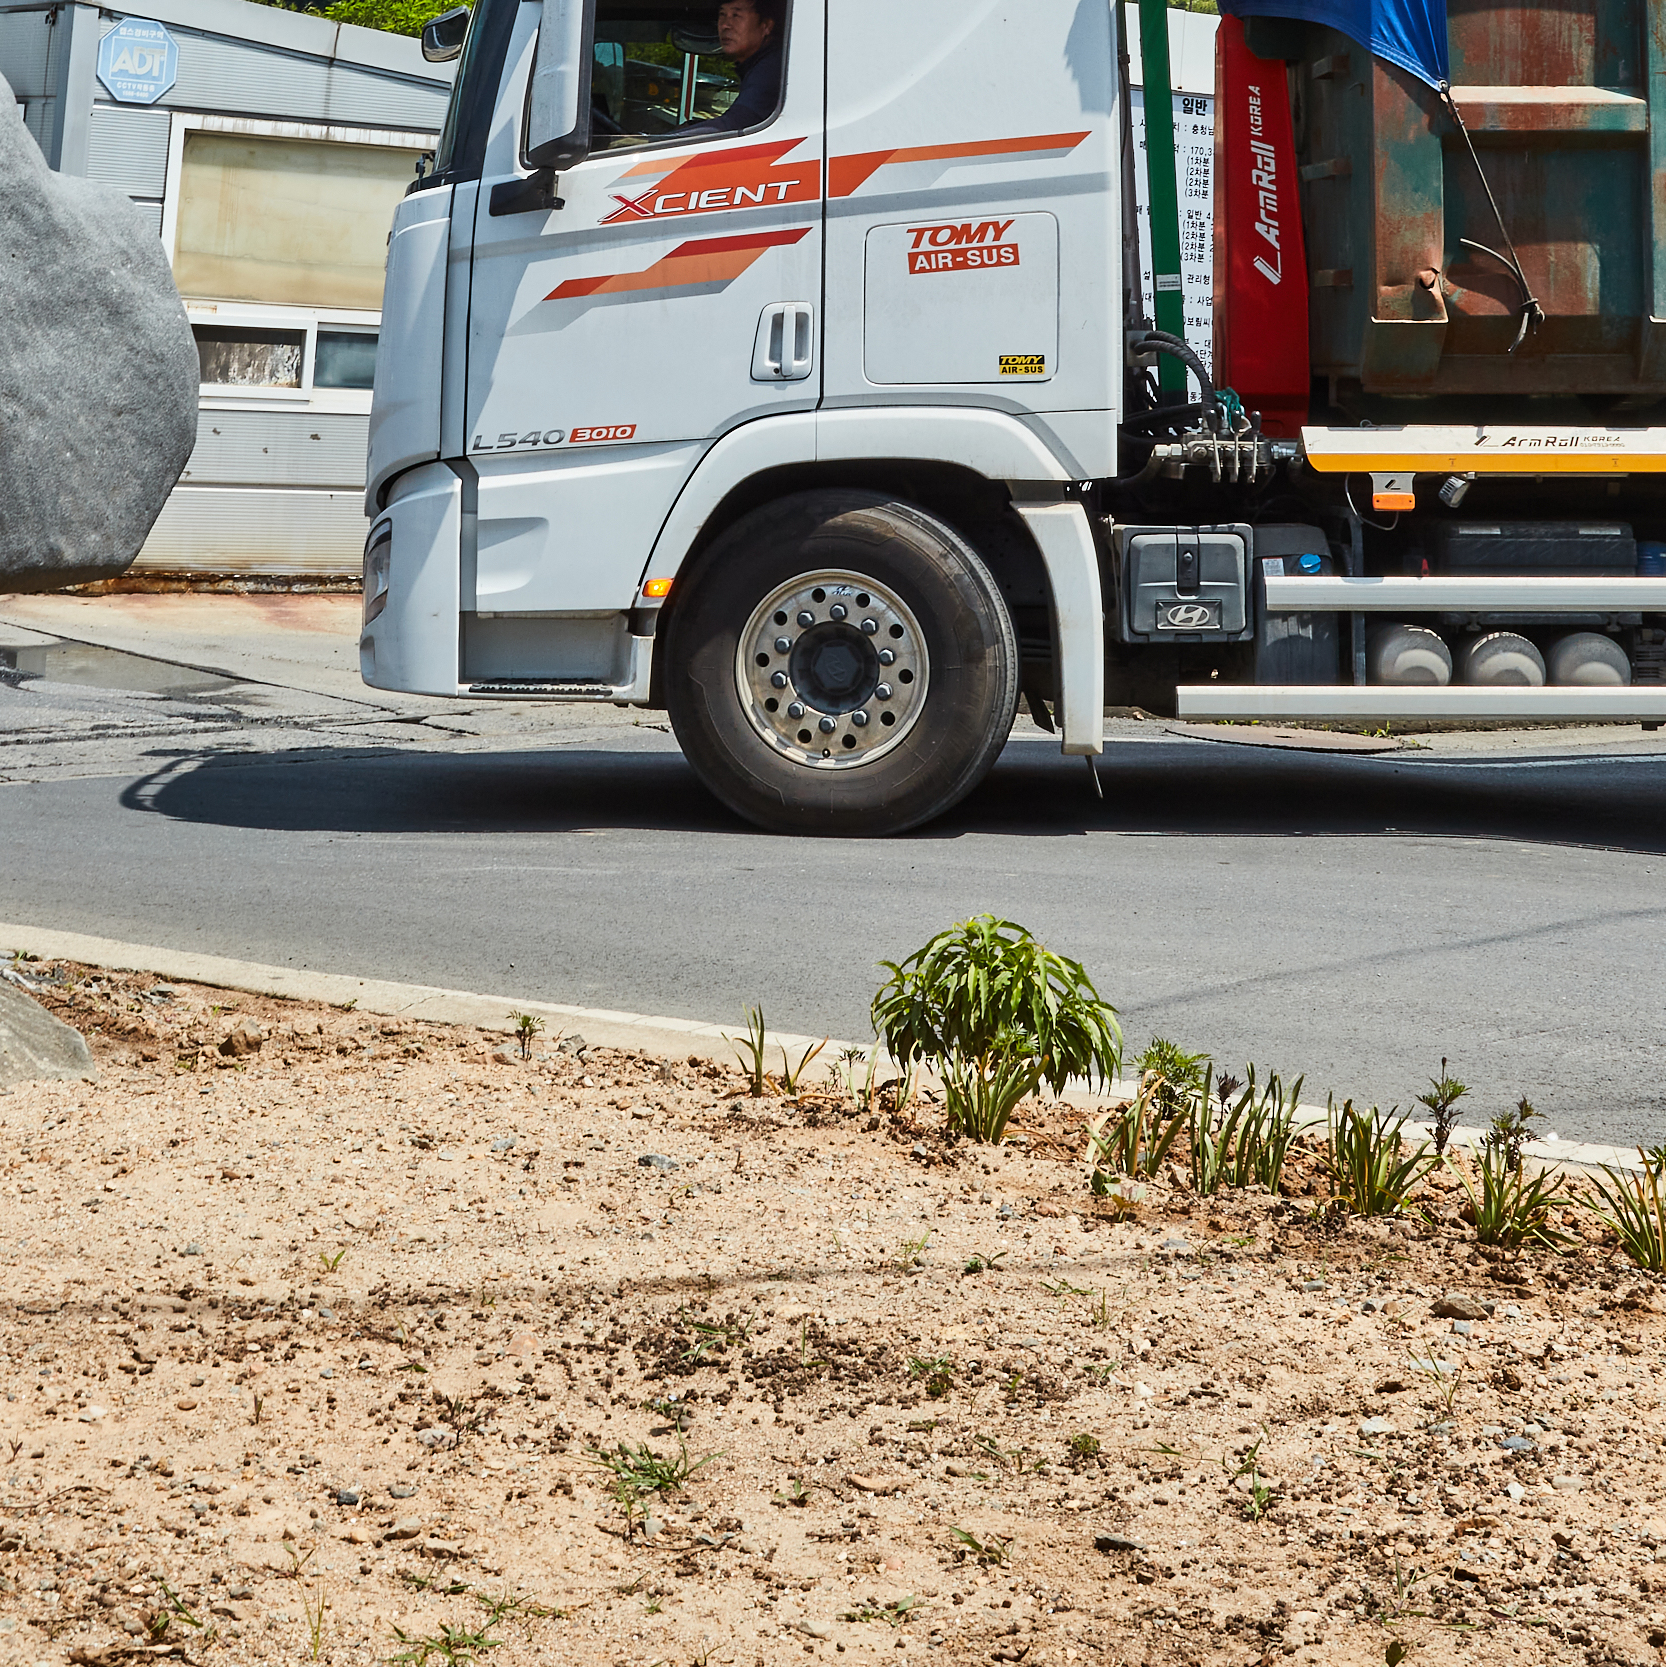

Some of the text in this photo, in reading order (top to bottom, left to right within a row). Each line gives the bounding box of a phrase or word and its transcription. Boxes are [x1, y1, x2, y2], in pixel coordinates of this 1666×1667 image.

[110, 45, 165, 77] ADT
[1182, 97, 1208, 117] 일반
[1248, 85, 1263, 137] KOREA
[597, 179, 801, 223] XCIENT
[906, 219, 1015, 250] TOMY
[914, 247, 1015, 271] AIR-SUS
[1000, 355, 1043, 365] TOMY
[1001, 365, 1043, 374] AIR-SUS
[472, 426, 632, 451] L540 3010
